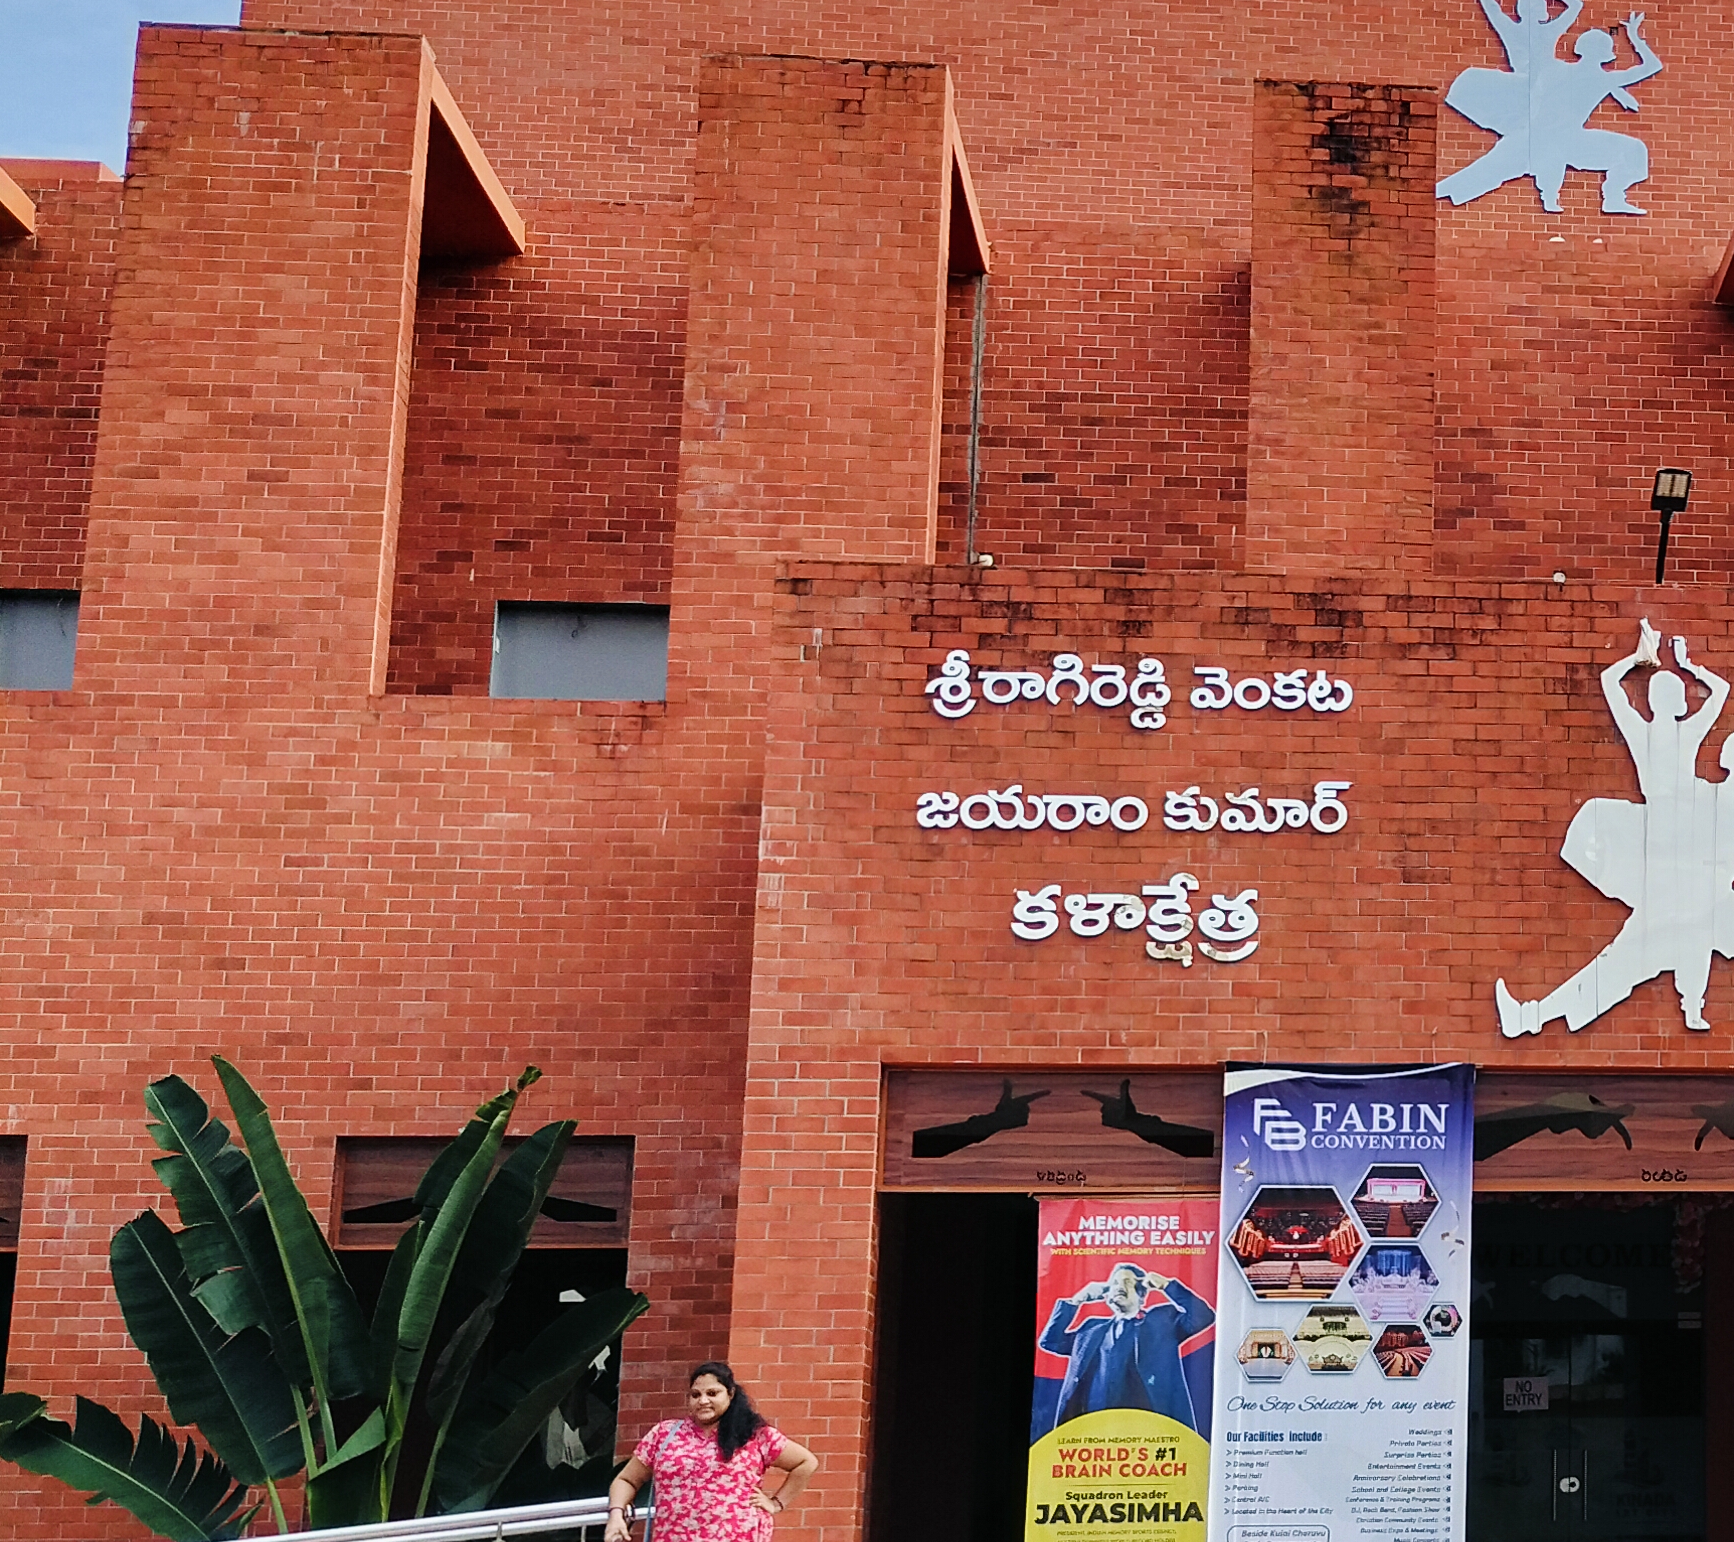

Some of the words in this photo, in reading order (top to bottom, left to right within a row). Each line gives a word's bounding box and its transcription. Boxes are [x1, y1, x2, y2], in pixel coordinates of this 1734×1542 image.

[1191, 665, 1354, 712] వెంకట
[916, 784, 1148, 831] జయరాం
[1163, 780, 1354, 834] కుమార్
[1010, 871, 1260, 968] కళాక్షేత్ర
[1312, 1102, 1450, 1134] FABIN
[1311, 1135, 1447, 1151] CONVENTION
[1078, 1216, 1181, 1230] MEMORISE
[1042, 1231, 1146, 1246] ANYTHING
[1151, 1230, 1216, 1245] EASILY
[1117, 1248, 1153, 1256] MEMORY
[1515, 1380, 1533, 1394] NO
[1227, 1395, 1258, 1412] One
[1260, 1395, 1296, 1414] Stop
[1298, 1395, 1359, 1412] Solution
[1360, 1397, 1385, 1414] for
[1391, 1401, 1418, 1414] any
[1423, 1400, 1457, 1411] event
[1505, 1393, 1543, 1406] ENTRY
[1226, 1431, 1242, 1442] Our
[1243, 1430, 1284, 1442] Facilities
[1289, 1429, 1323, 1442] Include
[1058, 1447, 1149, 1463] WORLD'S
[1155, 1447, 1177, 1461] #1
[1052, 1464, 1112, 1478] BRAIN
[1119, 1462, 1187, 1477] COACH
[1065, 1491, 1123, 1503] Squadron
[1127, 1490, 1168, 1500] Leader
[1034, 1501, 1204, 1525] JAYASIMHA
